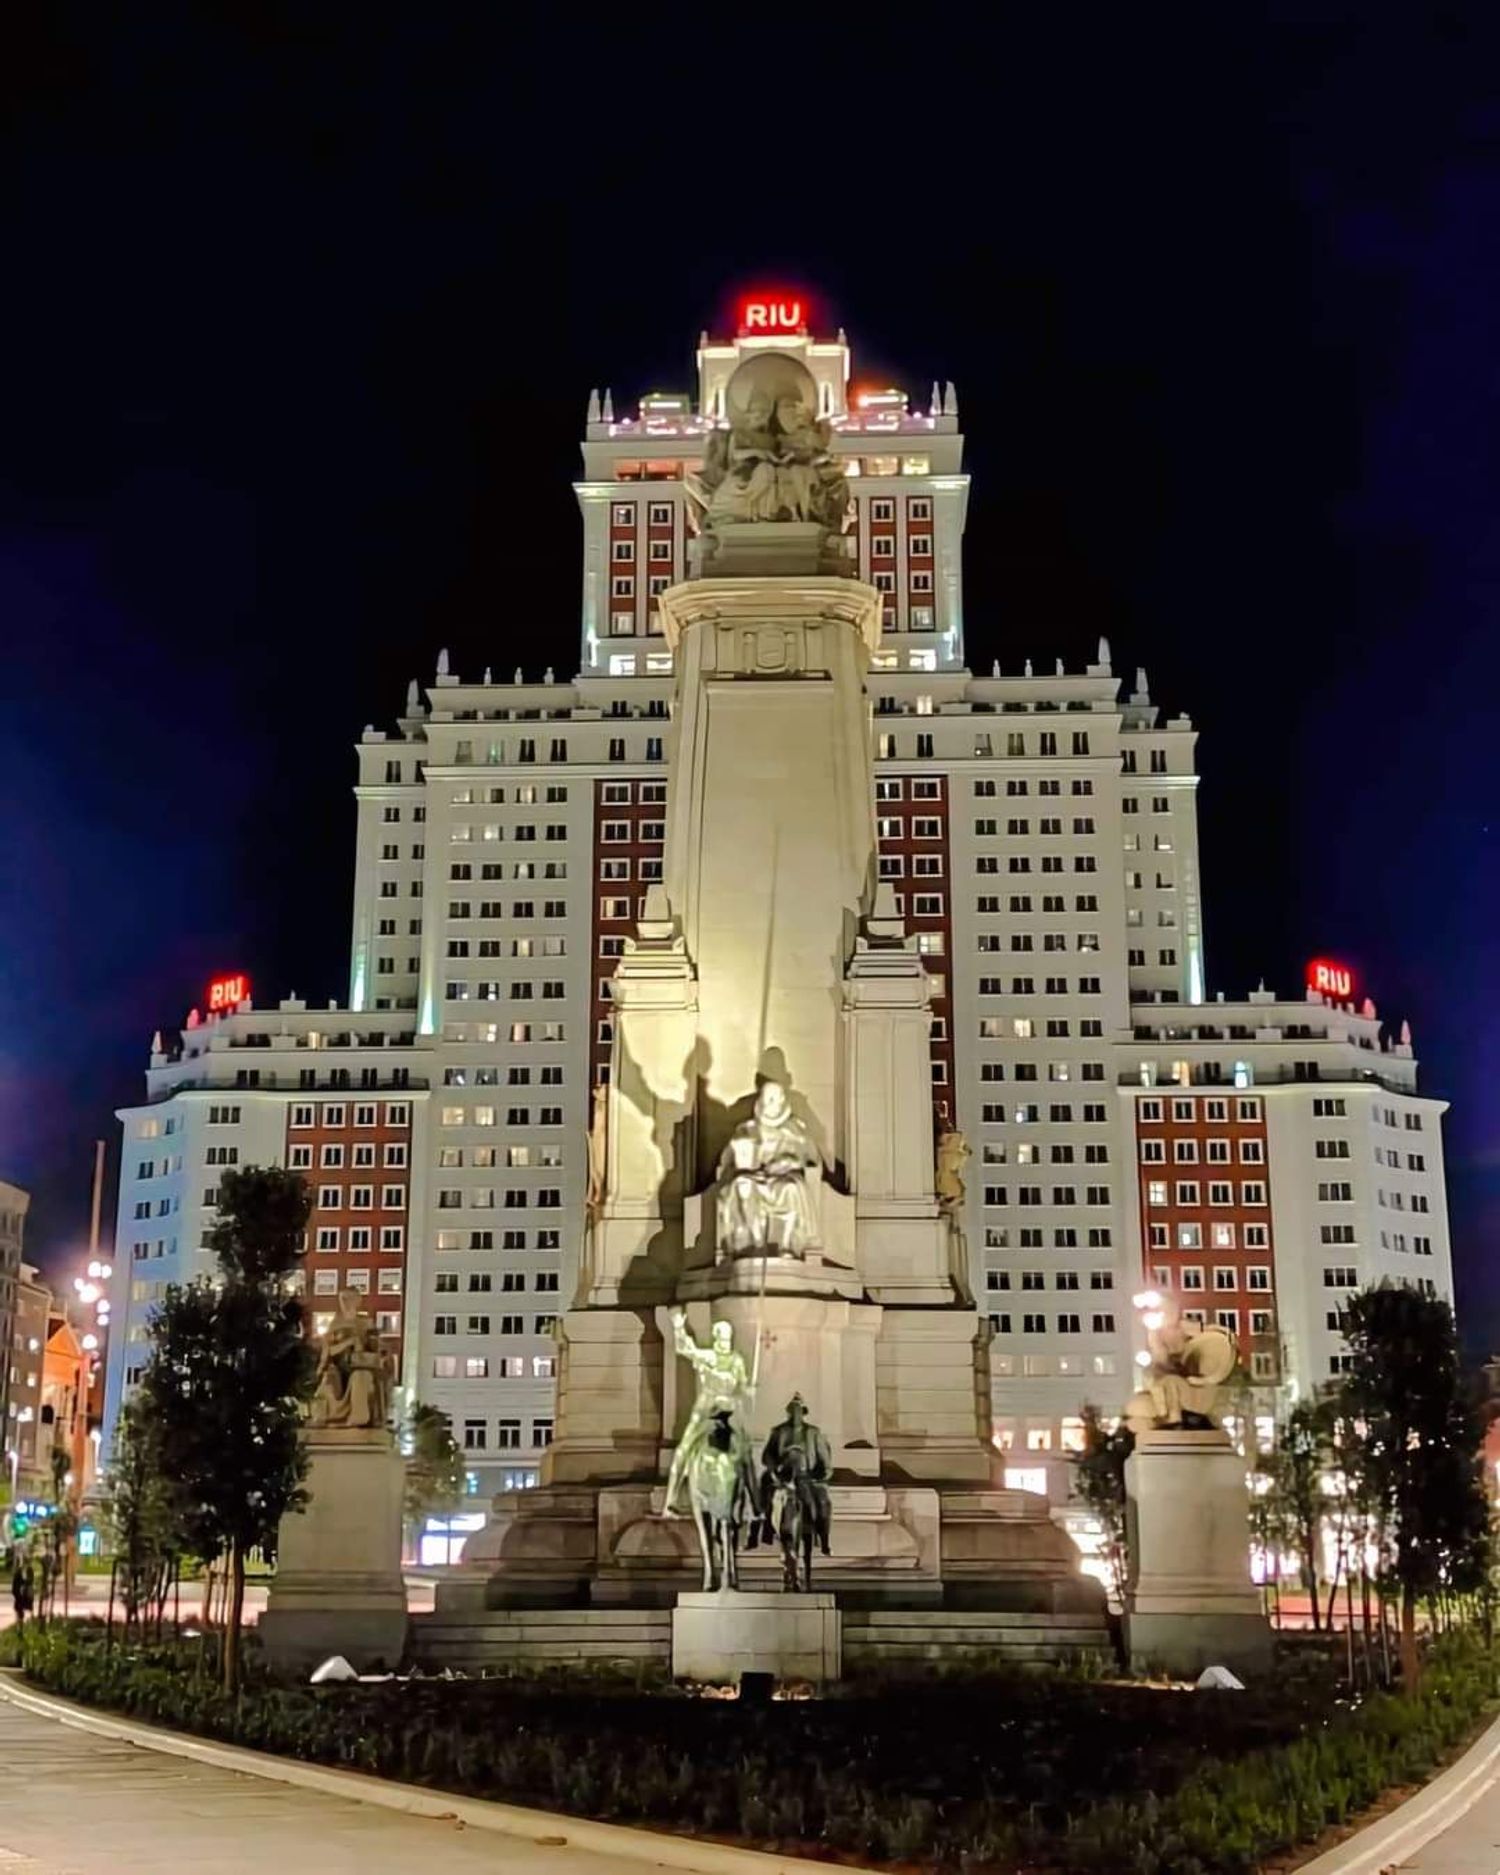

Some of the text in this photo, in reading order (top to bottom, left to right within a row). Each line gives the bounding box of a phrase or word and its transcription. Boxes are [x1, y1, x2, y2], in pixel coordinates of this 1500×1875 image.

[746, 303, 800, 327] RIU
[210, 976, 243, 1009] RIU
[1316, 965, 1350, 995] RIU
